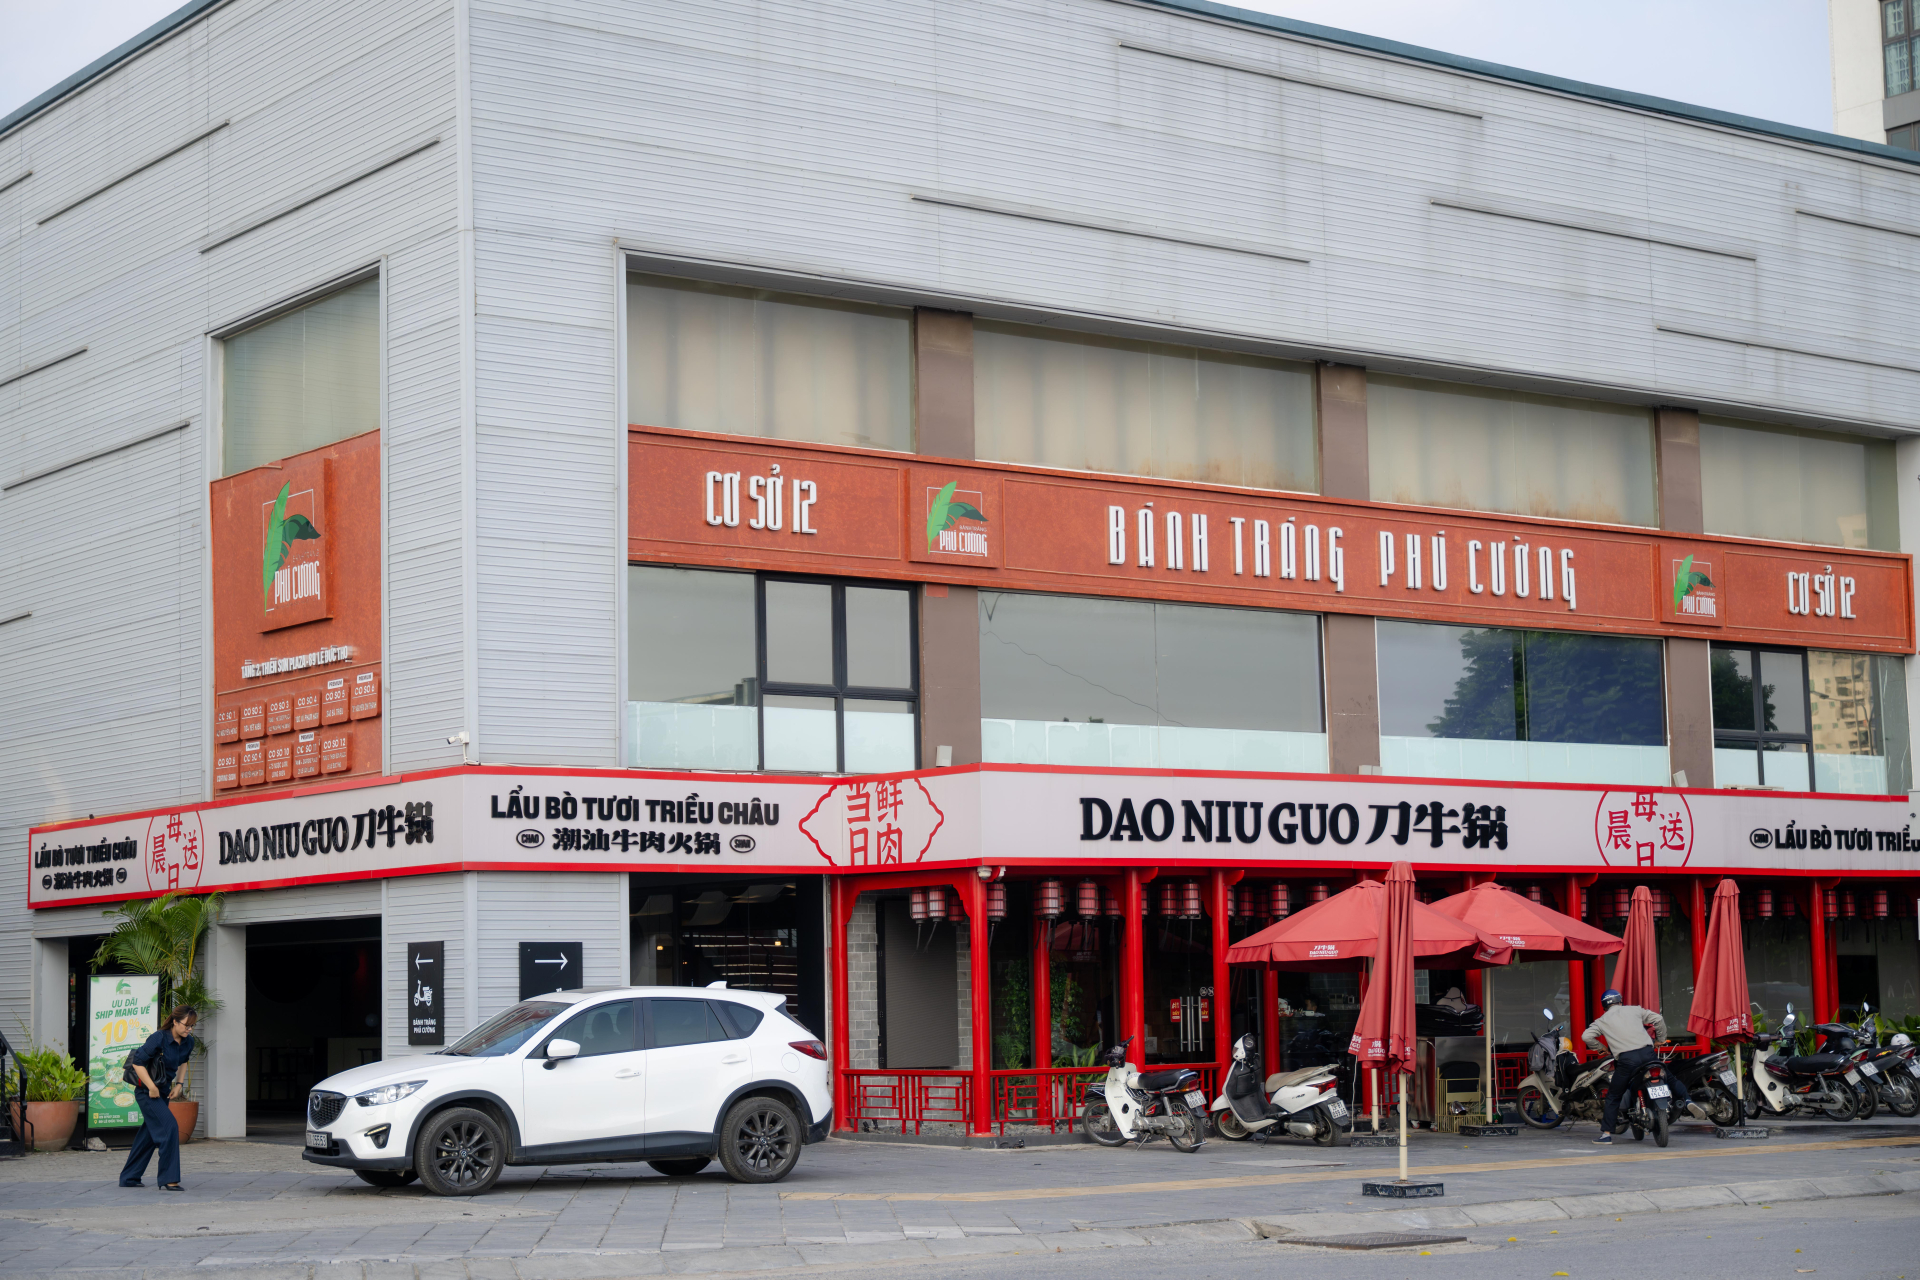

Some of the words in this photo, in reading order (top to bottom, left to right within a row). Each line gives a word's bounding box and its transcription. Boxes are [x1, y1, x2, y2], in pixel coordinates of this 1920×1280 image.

[706, 471, 740, 527] CƠ
[749, 463, 783, 530] SỞ
[793, 479, 817, 534] 12
[940, 530, 956, 552] PHÚ
[959, 531, 988, 557] CƯỜNG
[1109, 502, 1208, 572] BÁNH
[1229, 516, 1344, 592] TRÁNG
[1379, 530, 1447, 591] PHÚ
[1468, 535, 1576, 610] CƯỜNG
[274, 565, 290, 604] PHÚ
[292, 560, 320, 600] CƯỜNG
[1788, 572, 1809, 616] CƠ
[1814, 565, 1836, 617] SỞ
[1840, 576, 1856, 618] 12
[1682, 595, 1694, 613] PHÚ
[1696, 596, 1716, 618] CƯỜNG
[491, 784, 540, 819] LẨU
[545, 791, 578, 820] BÒ
[582, 795, 639, 821] TƯƠI
[645, 793, 713, 824] TRIỀU
[718, 797, 779, 826] CHÂU
[1079, 797, 1174, 842] DAO
[1181, 800, 1264, 844] NIU
[1268, 802, 1359, 845] GUO
[1365, 800, 1508, 850] 刀牛锅
[219, 826, 260, 865] DAO
[262, 822, 300, 861] NIU
[302, 816, 349, 855] GUO
[1775, 820, 1807, 849] LẨU
[1810, 825, 1832, 849] BÒ
[1834, 828, 1873, 850] TƯƠI
[95, 1010, 113, 1020] SHIP
[115, 1007, 138, 1018] MANG
[101, 1018, 140, 1045] 10%
